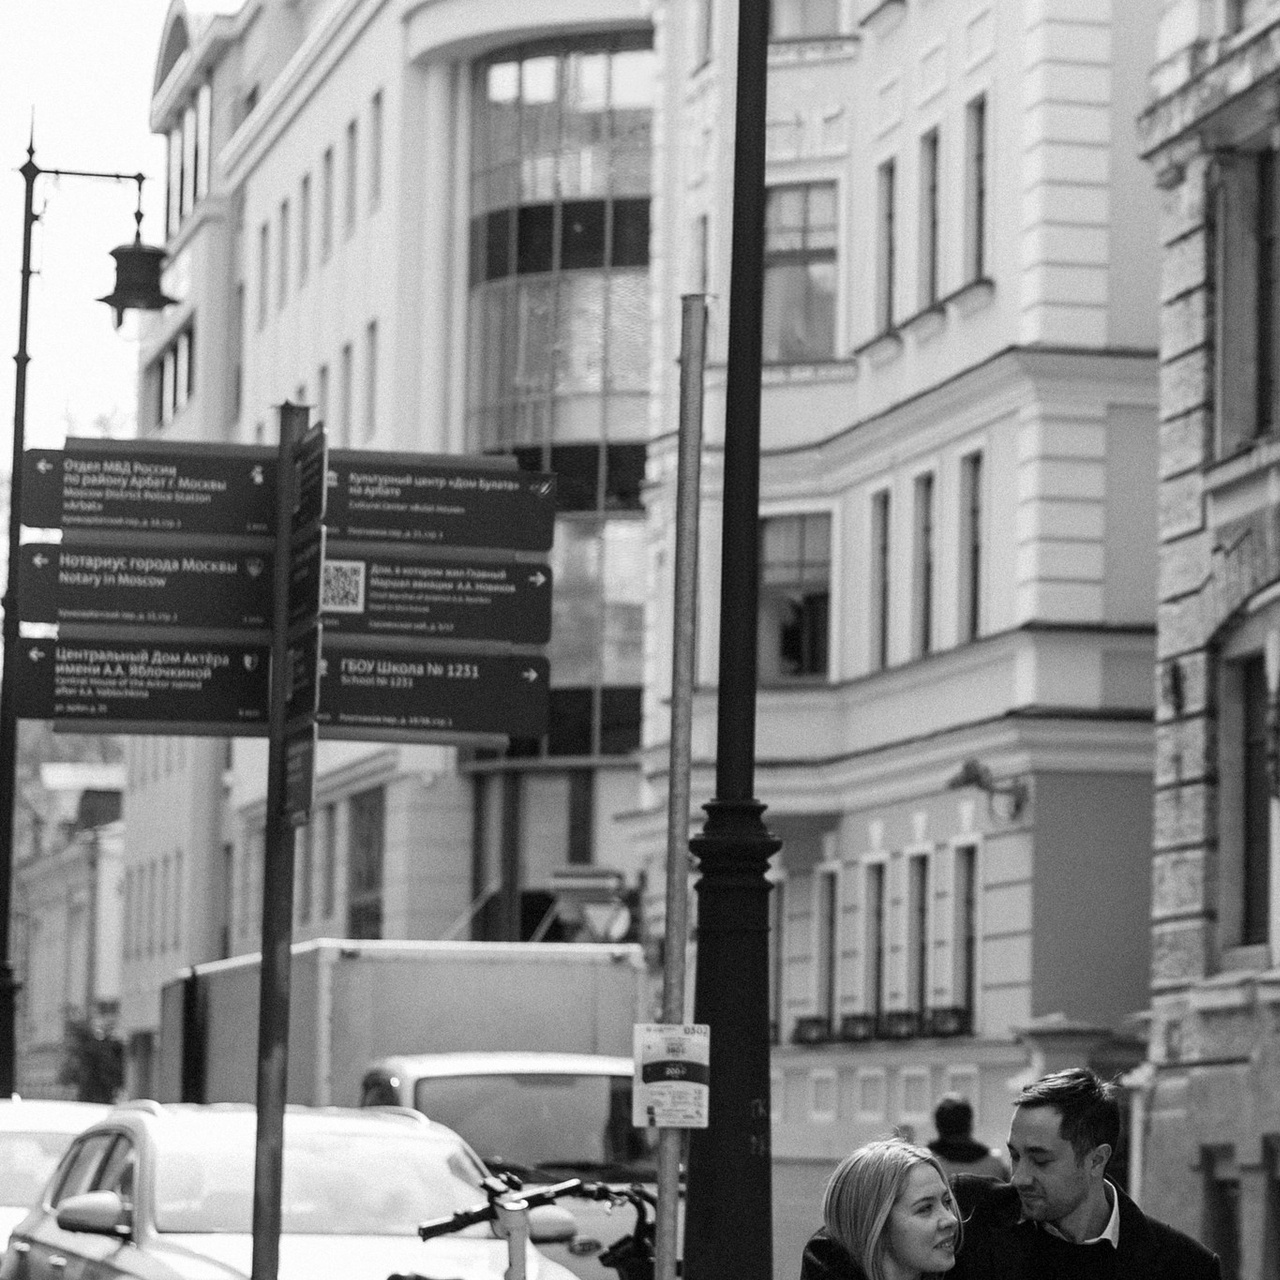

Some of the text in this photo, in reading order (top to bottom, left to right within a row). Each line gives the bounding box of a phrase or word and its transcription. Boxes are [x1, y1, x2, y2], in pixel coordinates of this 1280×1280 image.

[102, 460, 131, 475] МВД
[132, 461, 177, 476] России
[81, 474, 127, 488] району
[129, 476, 166, 489] Арбат
[178, 476, 227, 490] Москвы
[59, 553, 238, 574] Нотариус города Москвы
[58, 570, 167, 588] Notary in Moscow
[55, 647, 230, 669] Центральный Дом Актёра
[54, 664, 101, 675] имени
[128, 663, 212, 679] Яблочкиной
[341, 658, 375, 674] ГБОУ
[376, 660, 424, 675] Школа
[426, 661, 443, 676] №
[340, 674, 375, 686] School
